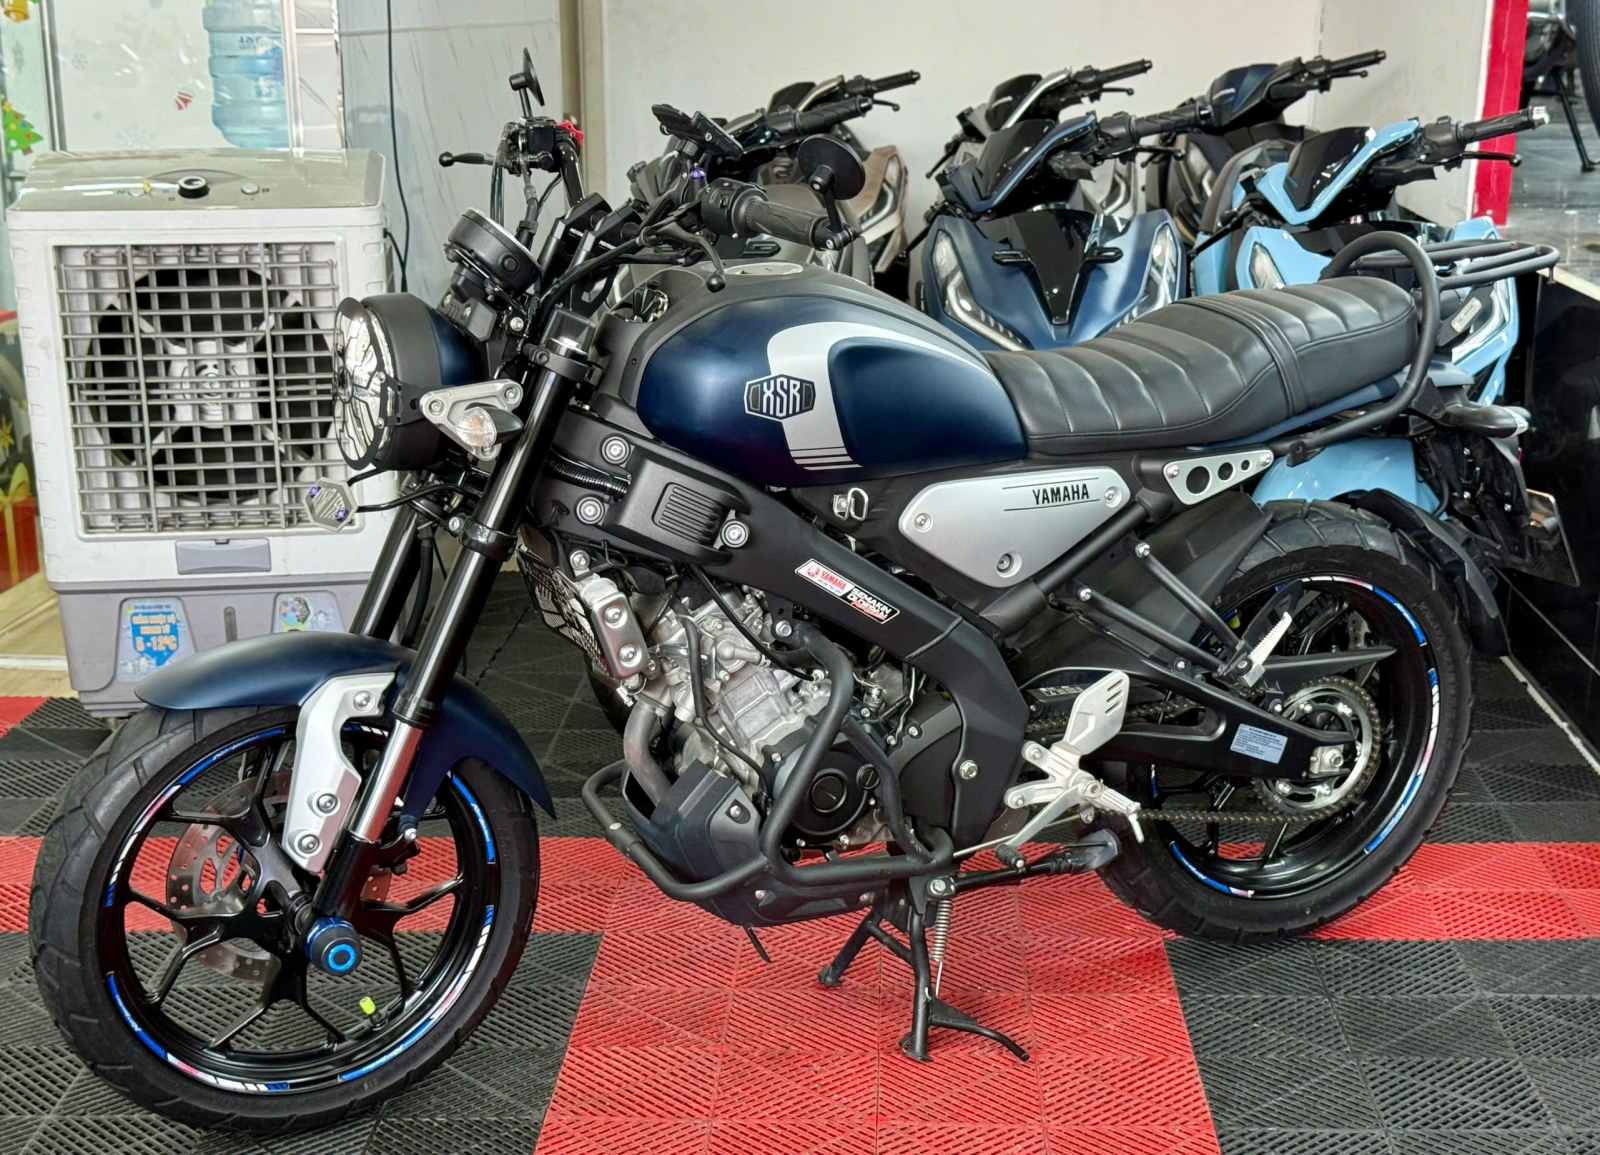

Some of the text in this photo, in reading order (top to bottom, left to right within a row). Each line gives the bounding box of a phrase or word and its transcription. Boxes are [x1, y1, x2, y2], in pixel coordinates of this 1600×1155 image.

[762, 377, 801, 418] XSR
[1032, 483, 1090, 505] YAMAHA
[821, 570, 847, 591] YAMAHA
[851, 588, 892, 614] SEMAKIN
